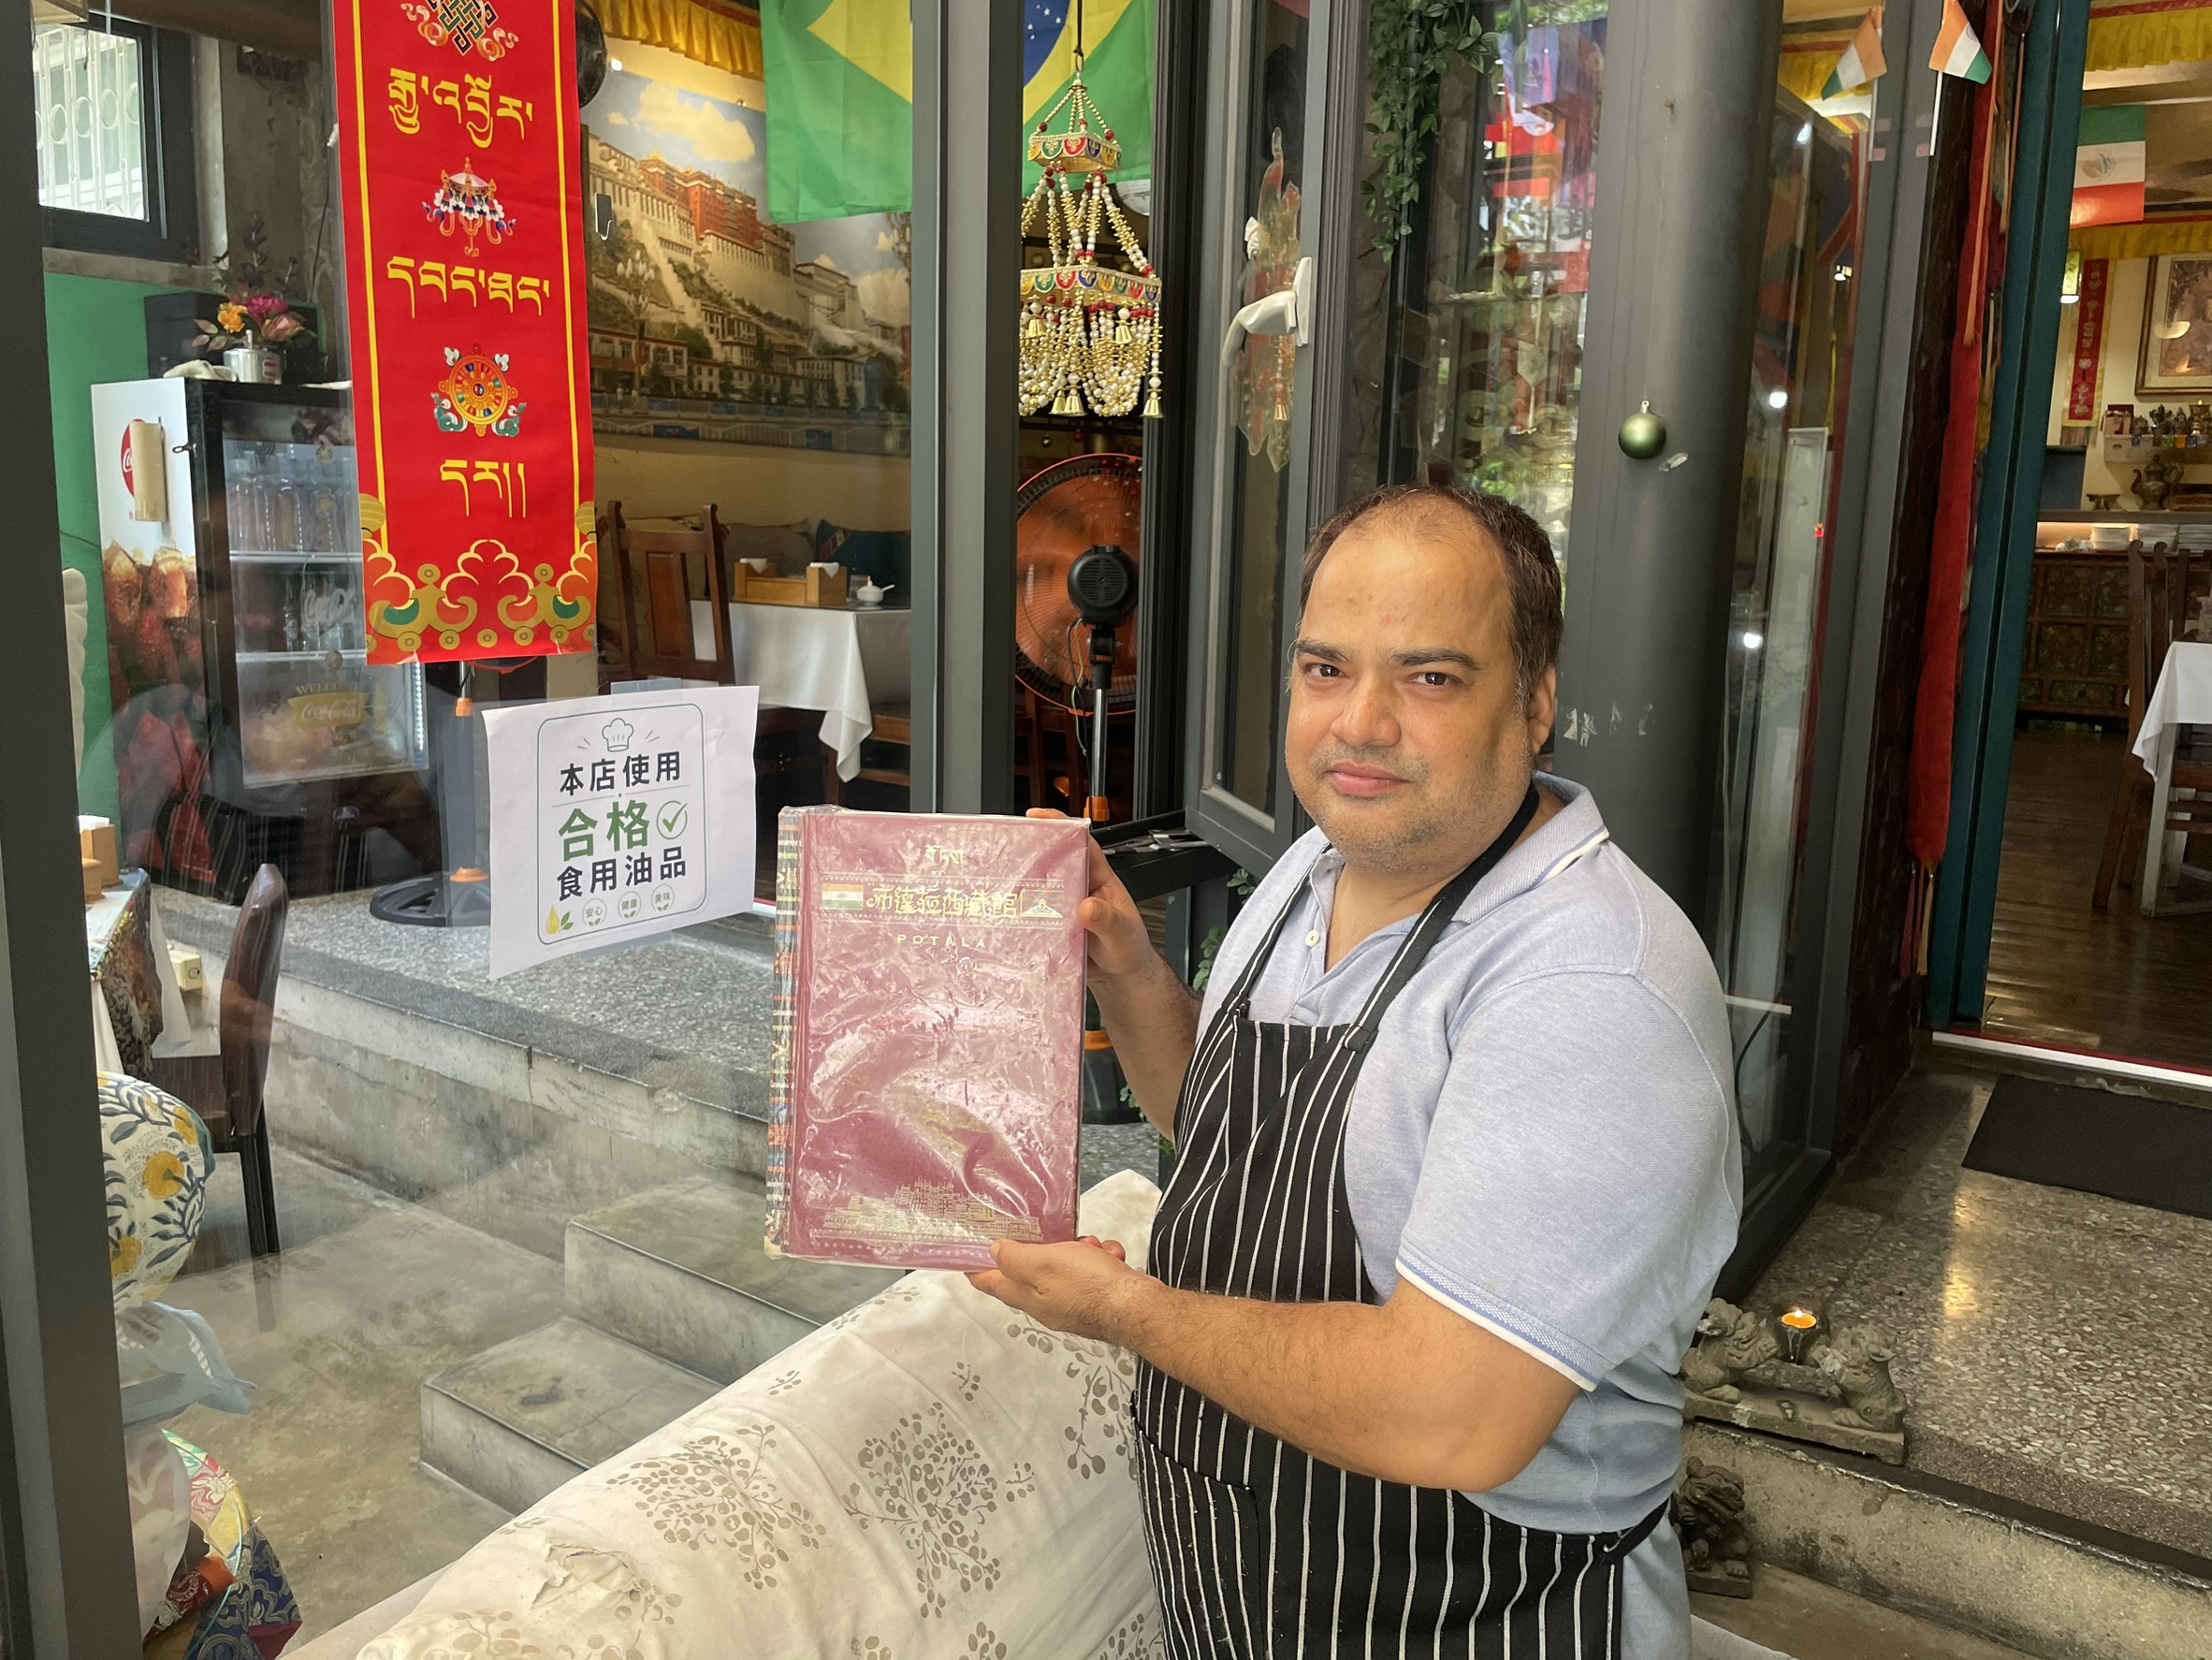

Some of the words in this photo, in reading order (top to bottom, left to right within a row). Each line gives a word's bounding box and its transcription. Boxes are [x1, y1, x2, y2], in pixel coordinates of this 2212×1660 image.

[386, 255, 550, 319] དབང་ཐང་
[559, 750, 681, 796] 本店使用
[558, 799, 650, 862] 合格
[557, 846, 687, 902] 食用油品
[585, 906, 604, 919] 安心
[621, 898, 638, 911] 健康
[655, 892, 671, 904] 美味
[895, 934, 986, 949] POTALA
